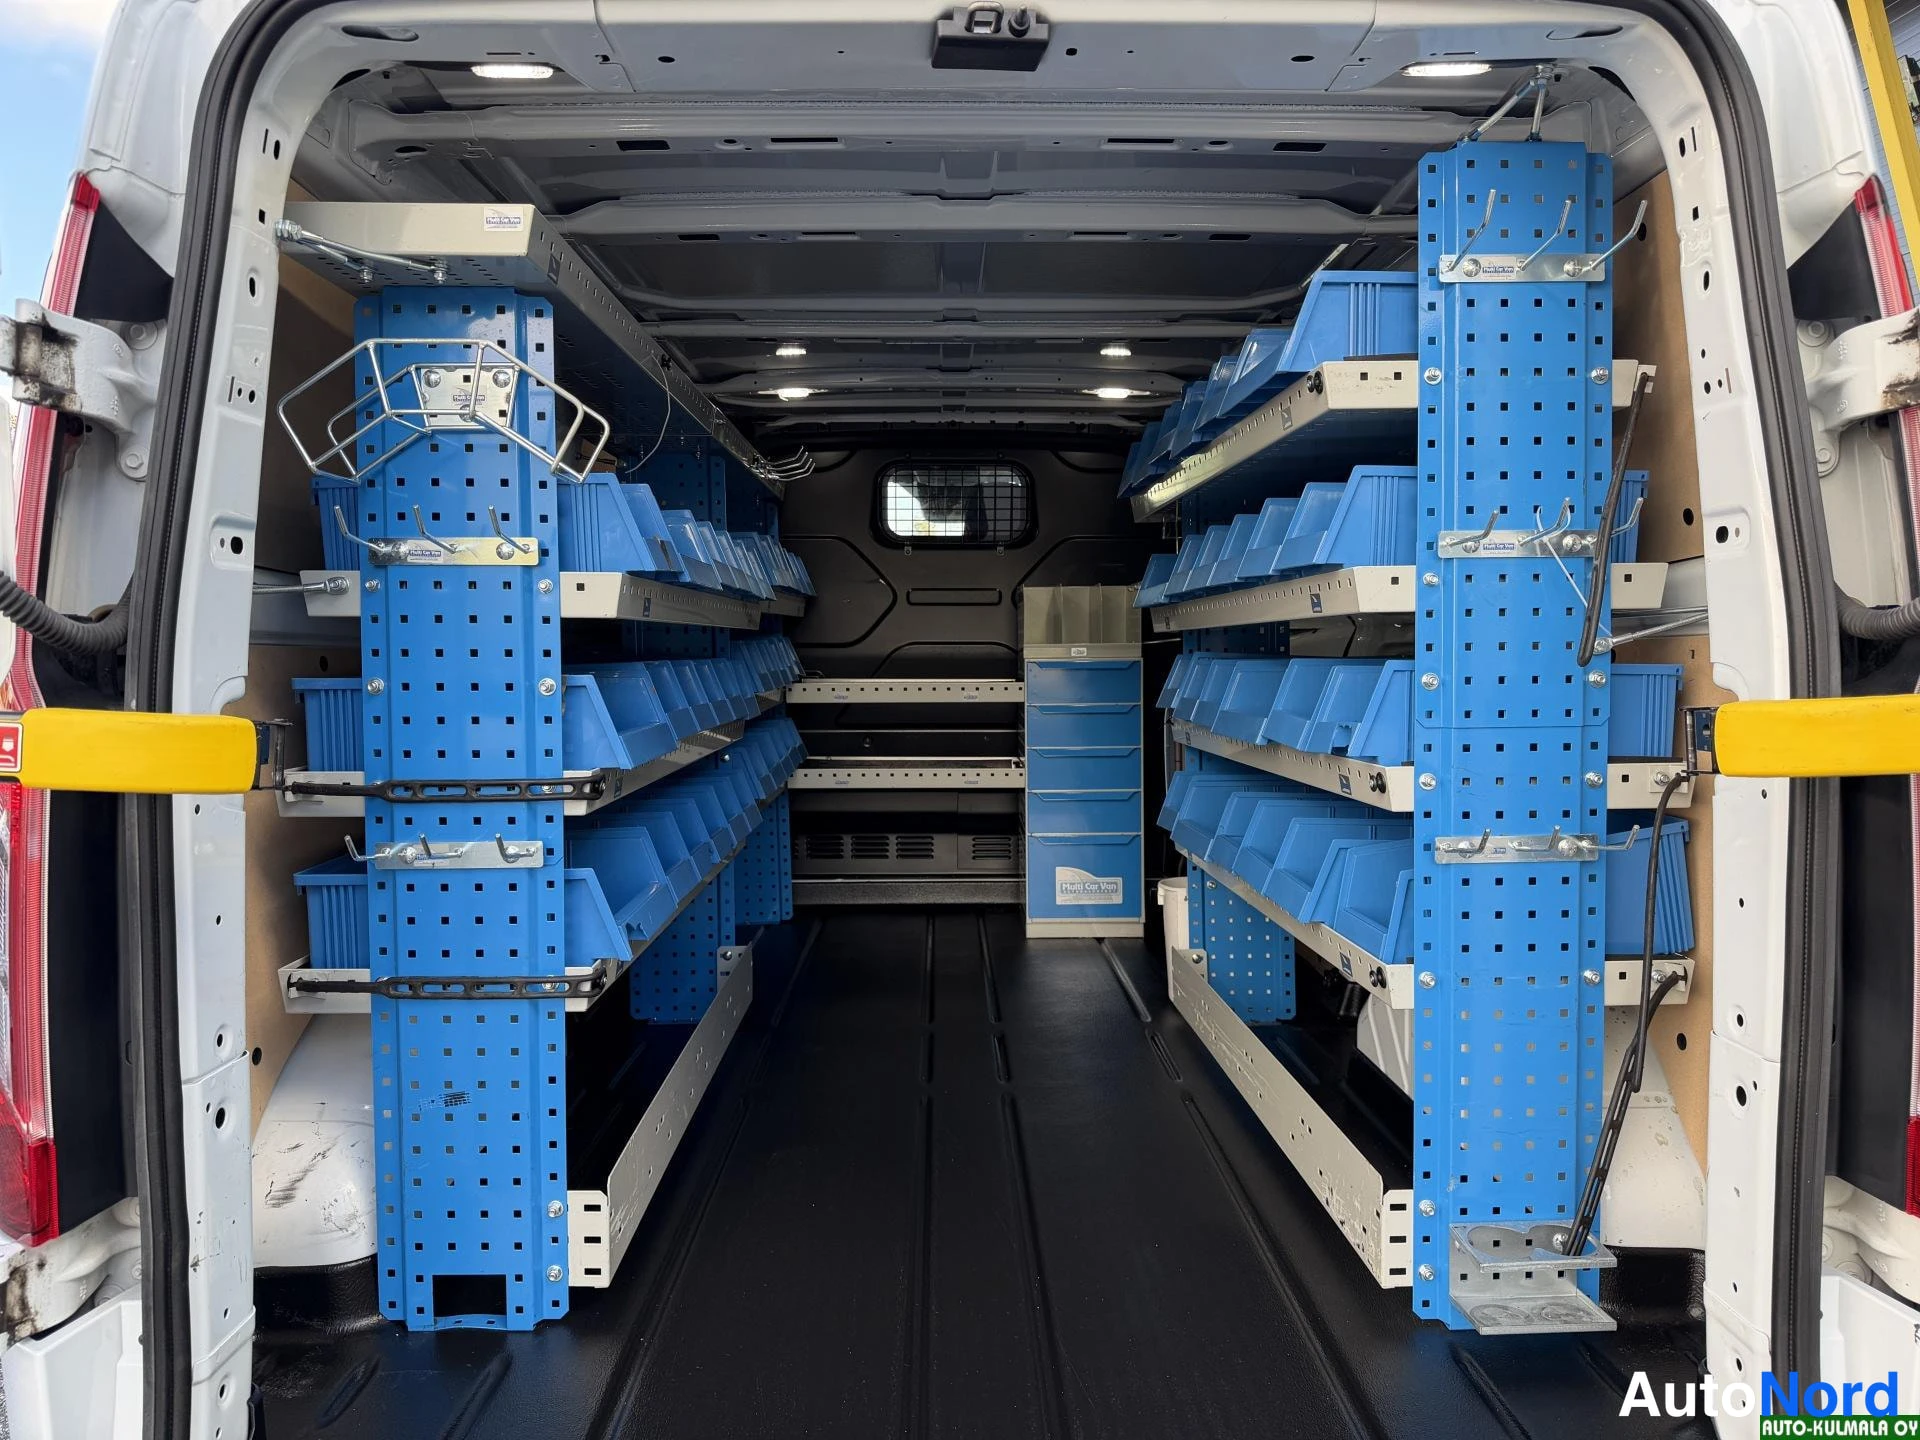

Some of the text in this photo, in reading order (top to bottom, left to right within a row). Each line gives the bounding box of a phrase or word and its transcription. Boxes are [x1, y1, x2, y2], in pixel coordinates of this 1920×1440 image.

[1062, 882, 1117, 890] Multi Car Van
